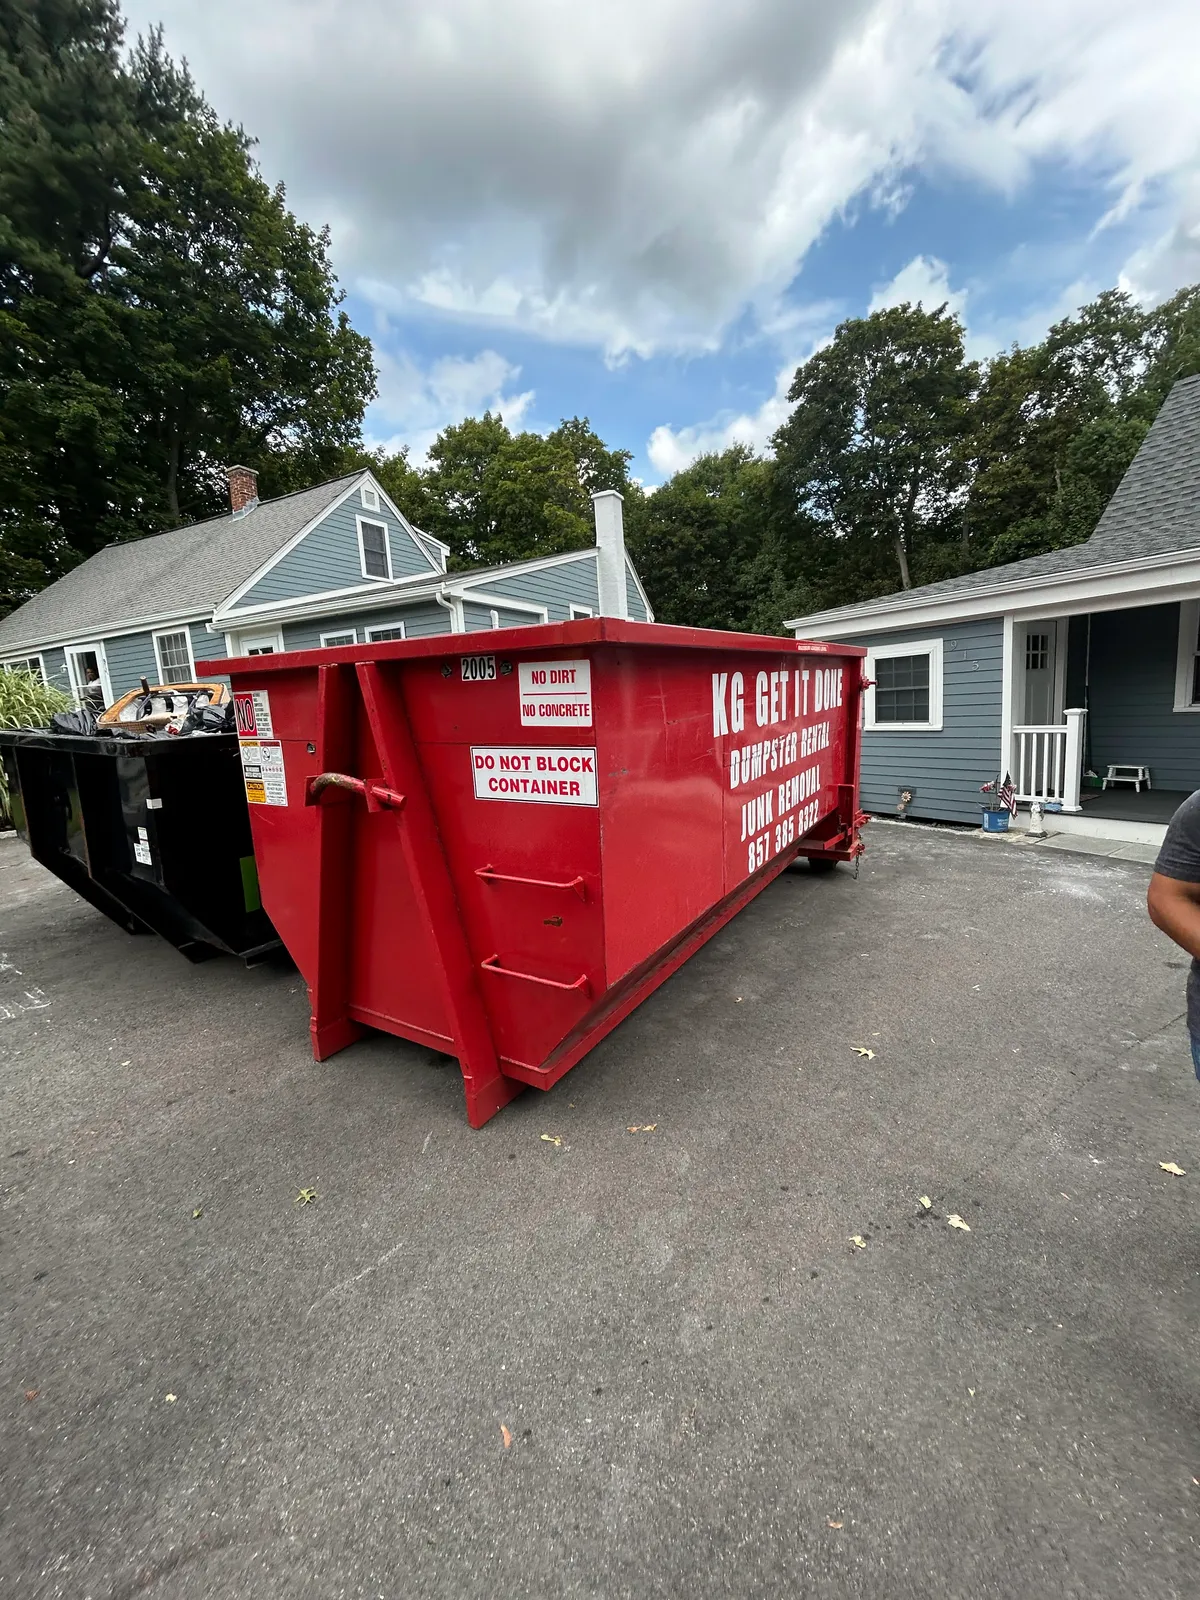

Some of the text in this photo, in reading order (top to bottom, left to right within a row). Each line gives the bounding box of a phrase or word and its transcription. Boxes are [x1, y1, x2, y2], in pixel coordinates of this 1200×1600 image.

[462, 657, 495, 680] 2005
[531, 669, 577, 684] NO DIRT
[234, 698, 256, 732] NO
[522, 703, 590, 717] NO CONCRETE
[712, 668, 843, 738] KG GET IT DONE
[475, 755, 594, 773] DO NOT BLOCK
[730, 721, 830, 789] DUMPSTER RENTAL
[488, 777, 581, 796] CONTAINER
[741, 764, 821, 843] JUNK REMOVAL
[748, 799, 819, 874] 857 385 8322
